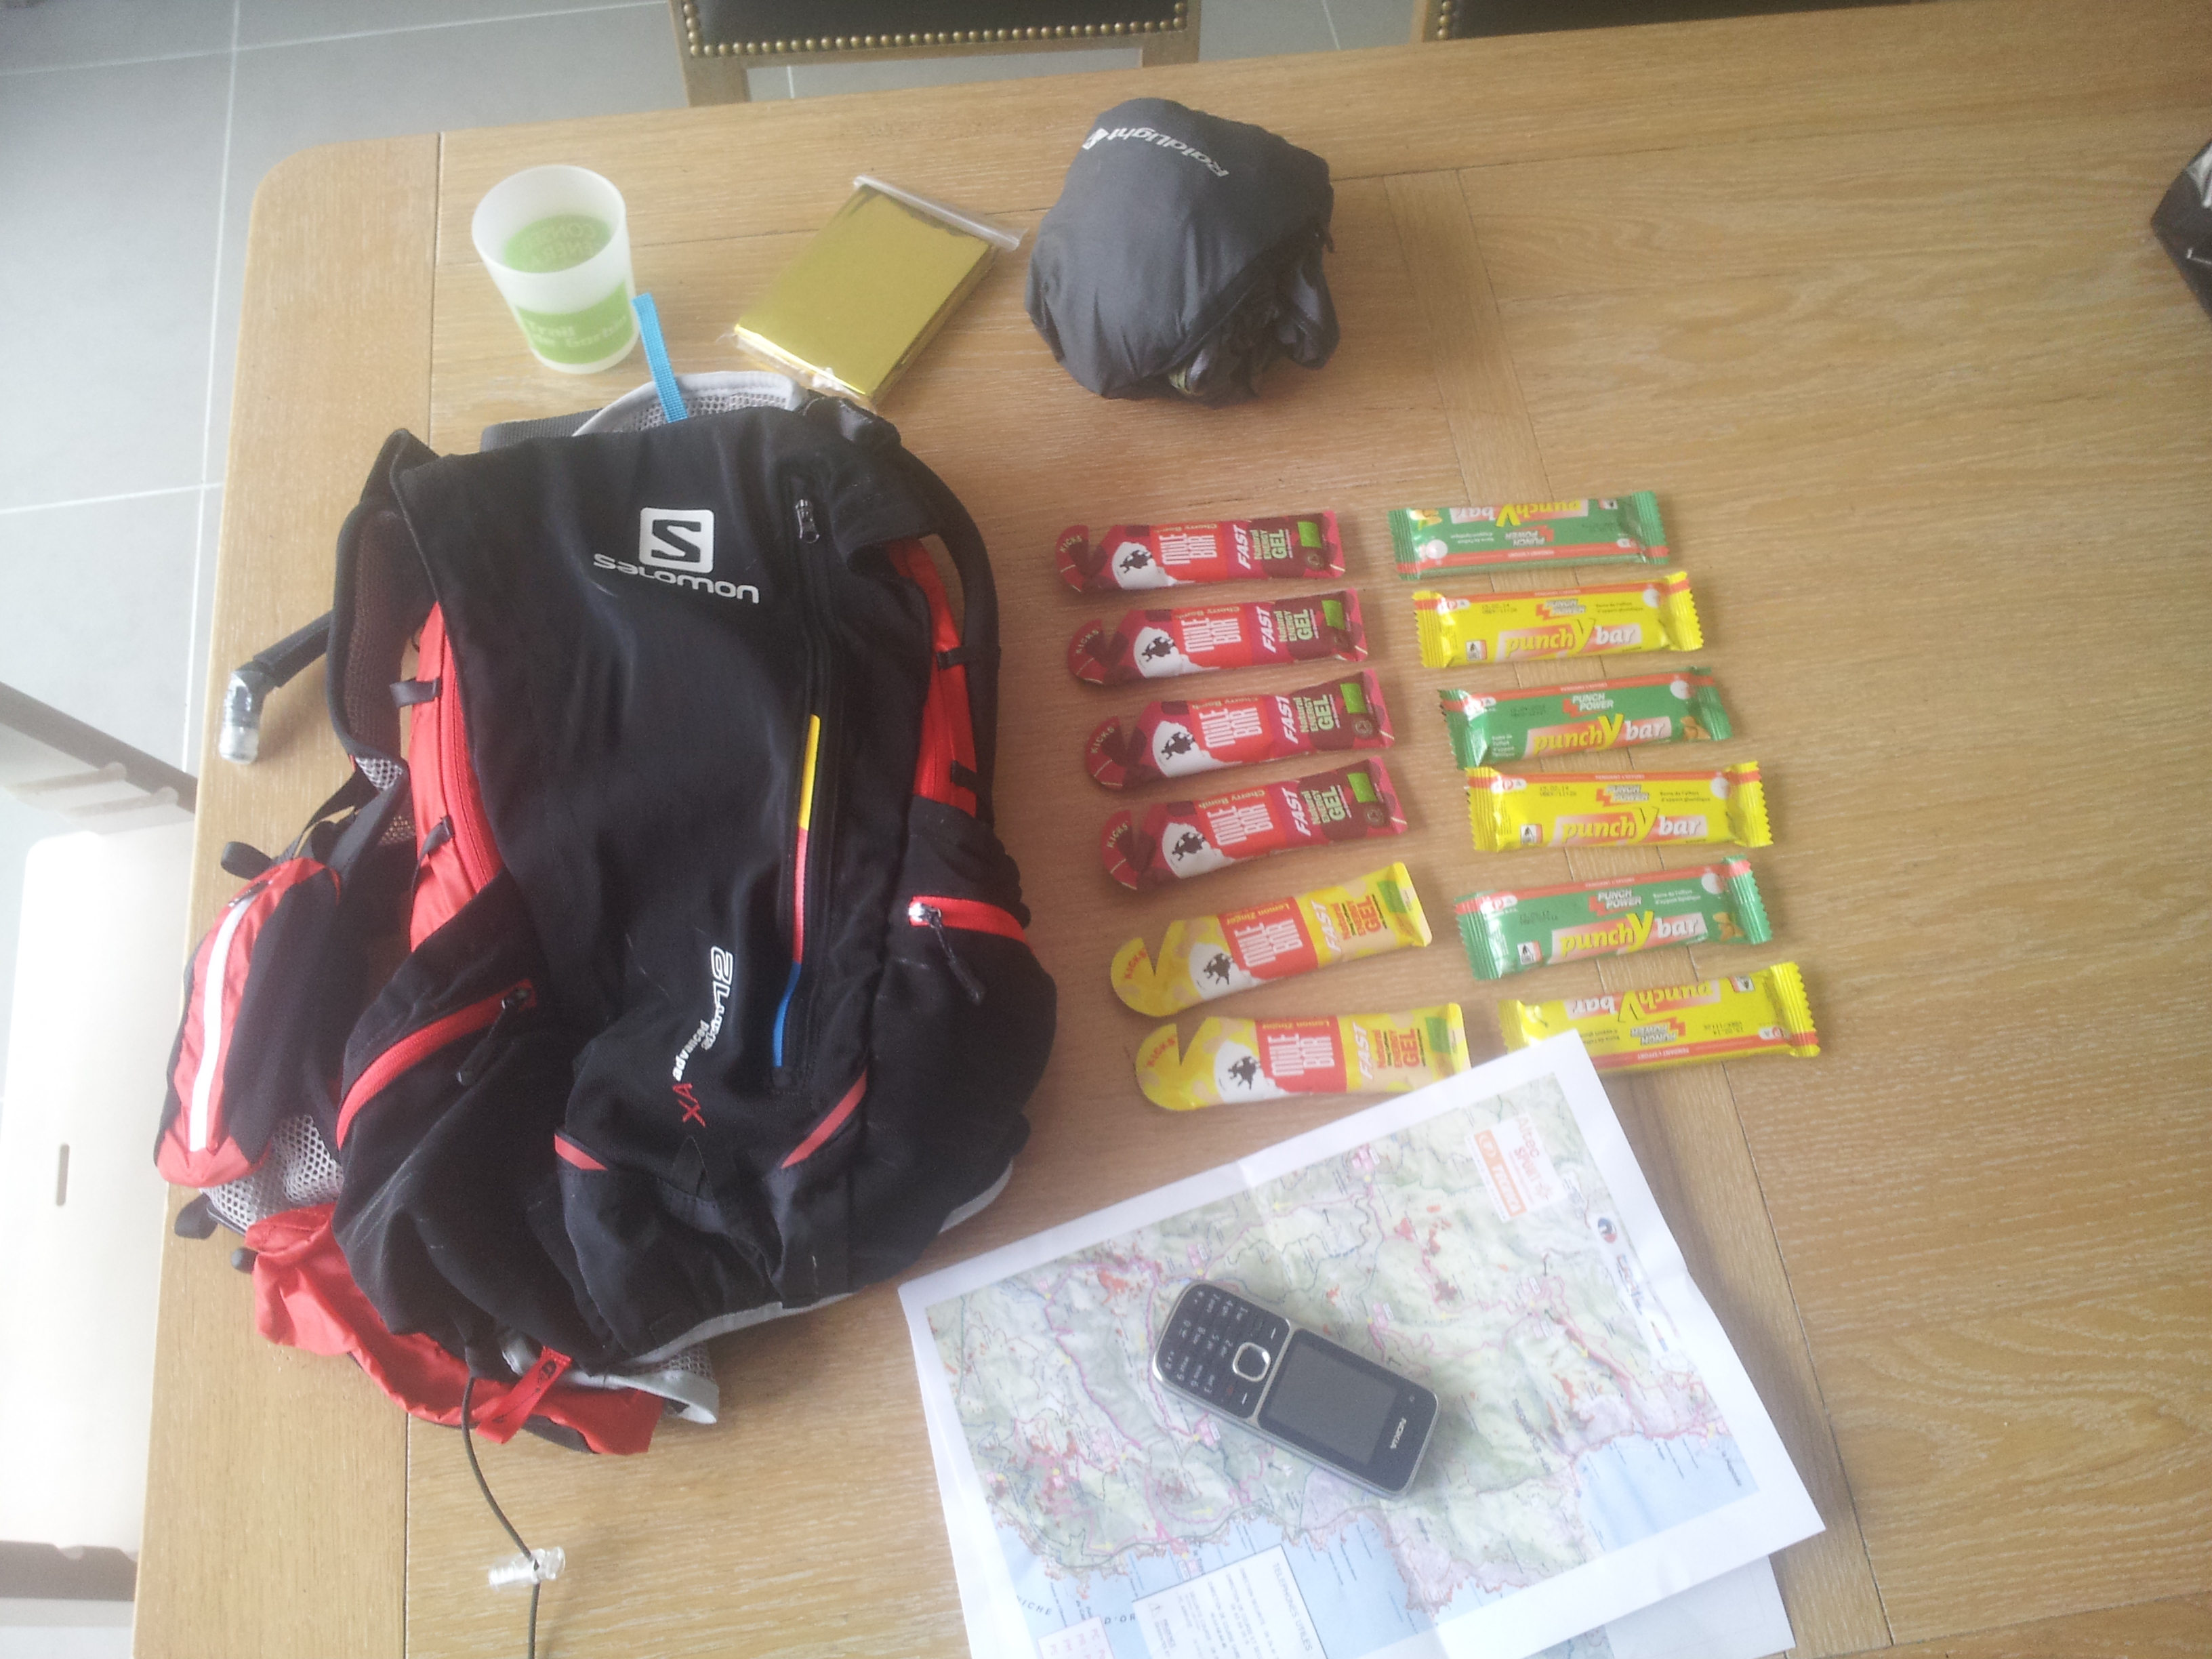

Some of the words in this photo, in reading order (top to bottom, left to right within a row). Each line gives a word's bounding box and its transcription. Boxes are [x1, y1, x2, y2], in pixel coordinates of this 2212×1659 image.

[1233, 524, 1251, 570] FAST
[1269, 529, 1288, 560] GEL
[1256, 606, 1277, 654] FAST
[1294, 609, 1313, 640] GEL
[1594, 625, 1635, 644] bar
[1275, 696, 1299, 743] FAST
[1313, 695, 1335, 731] GEL
[1624, 720, 1665, 739] bar
[1281, 787, 1311, 836] FAST
[1322, 785, 1346, 821] GEL
[1657, 815, 1698, 836] bar
[1311, 899, 1342, 952] FAST
[1357, 895, 1381, 933] GEL
[1656, 916, 1698, 937] bar
[1352, 1022, 1374, 1080] FAST
[1400, 1028, 1420, 1067] GEL
